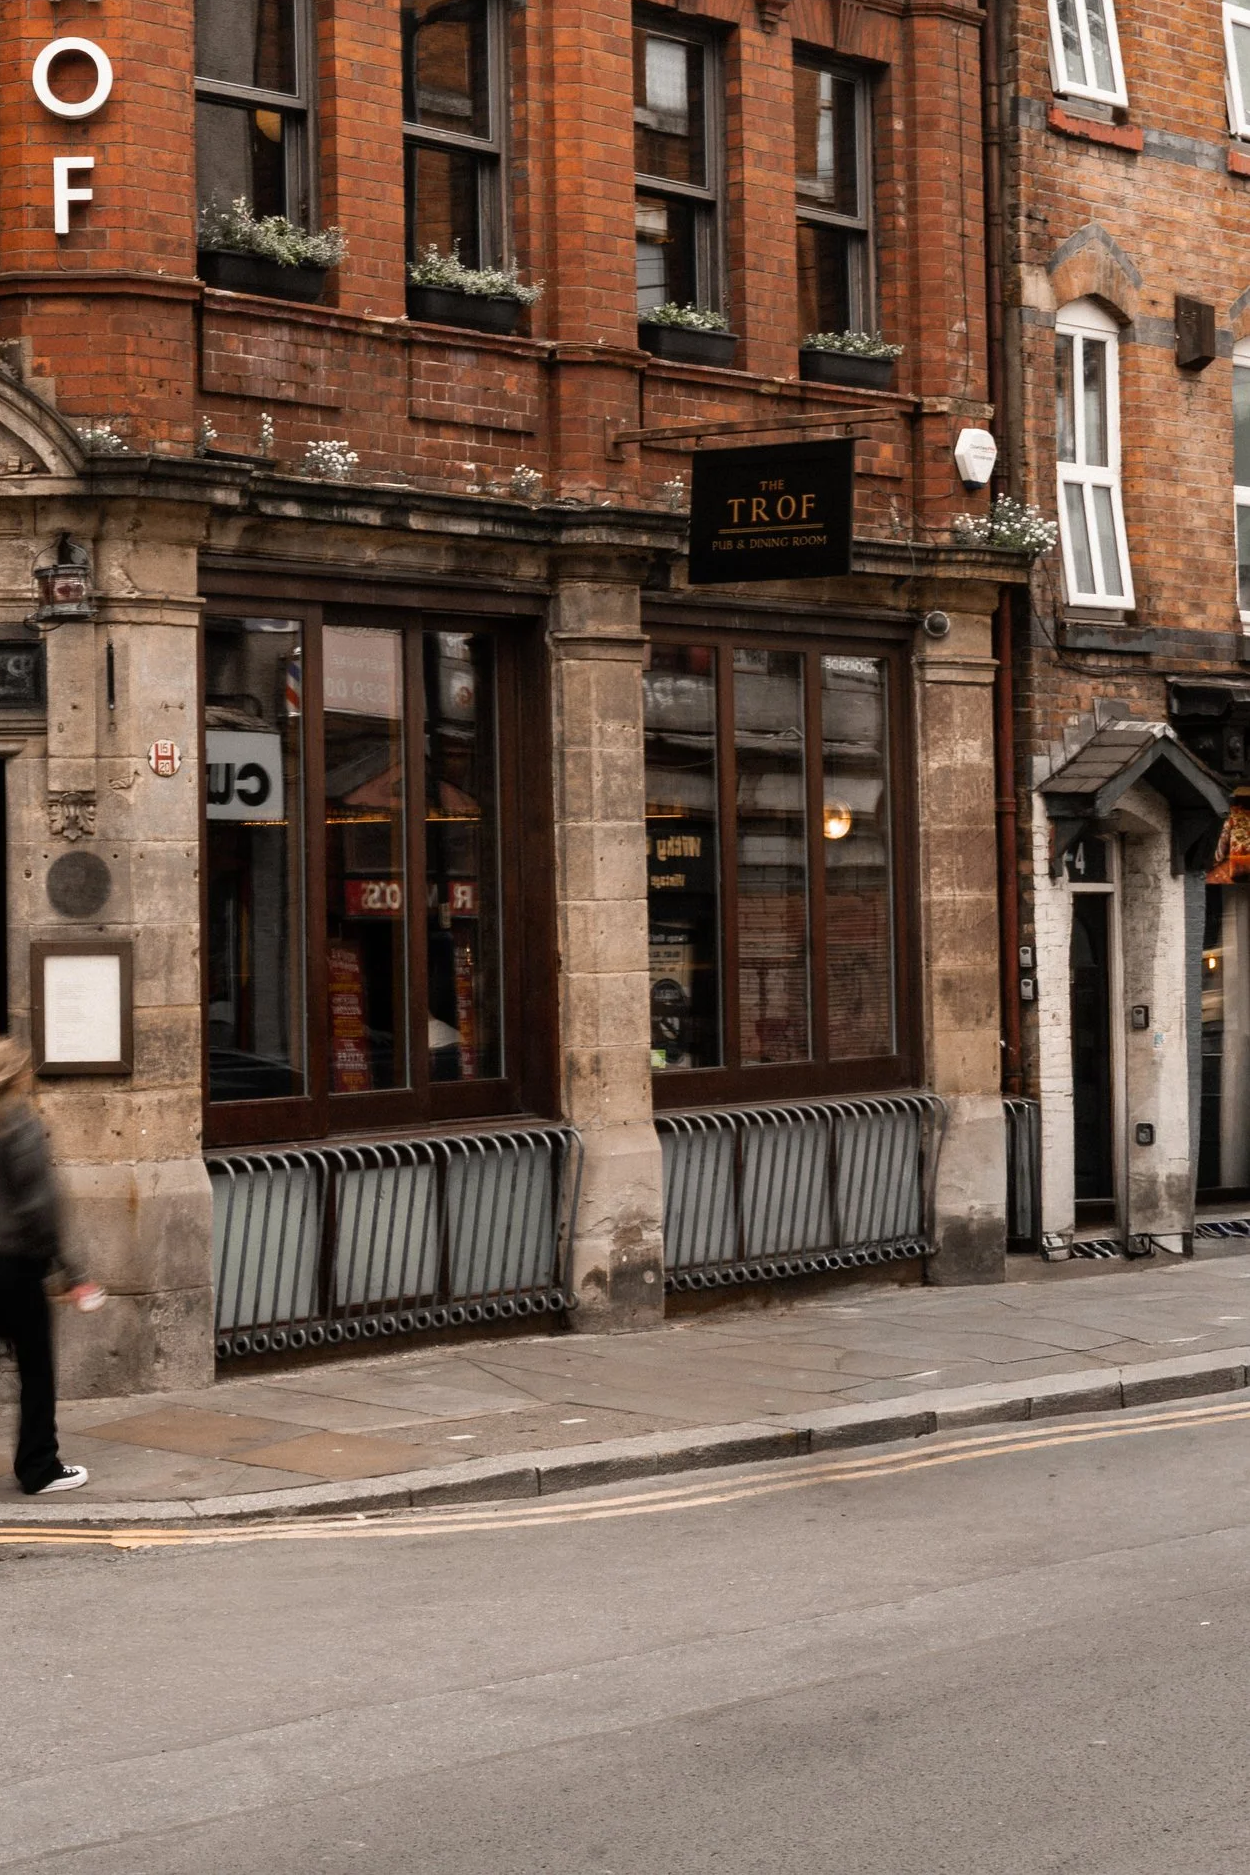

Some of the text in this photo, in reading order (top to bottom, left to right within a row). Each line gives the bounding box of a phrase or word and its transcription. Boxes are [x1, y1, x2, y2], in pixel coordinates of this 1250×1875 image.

[758, 478, 786, 492] THE
[726, 494, 816, 523] TROF
[711, 534, 828, 551] PUB & DINING ROOM
